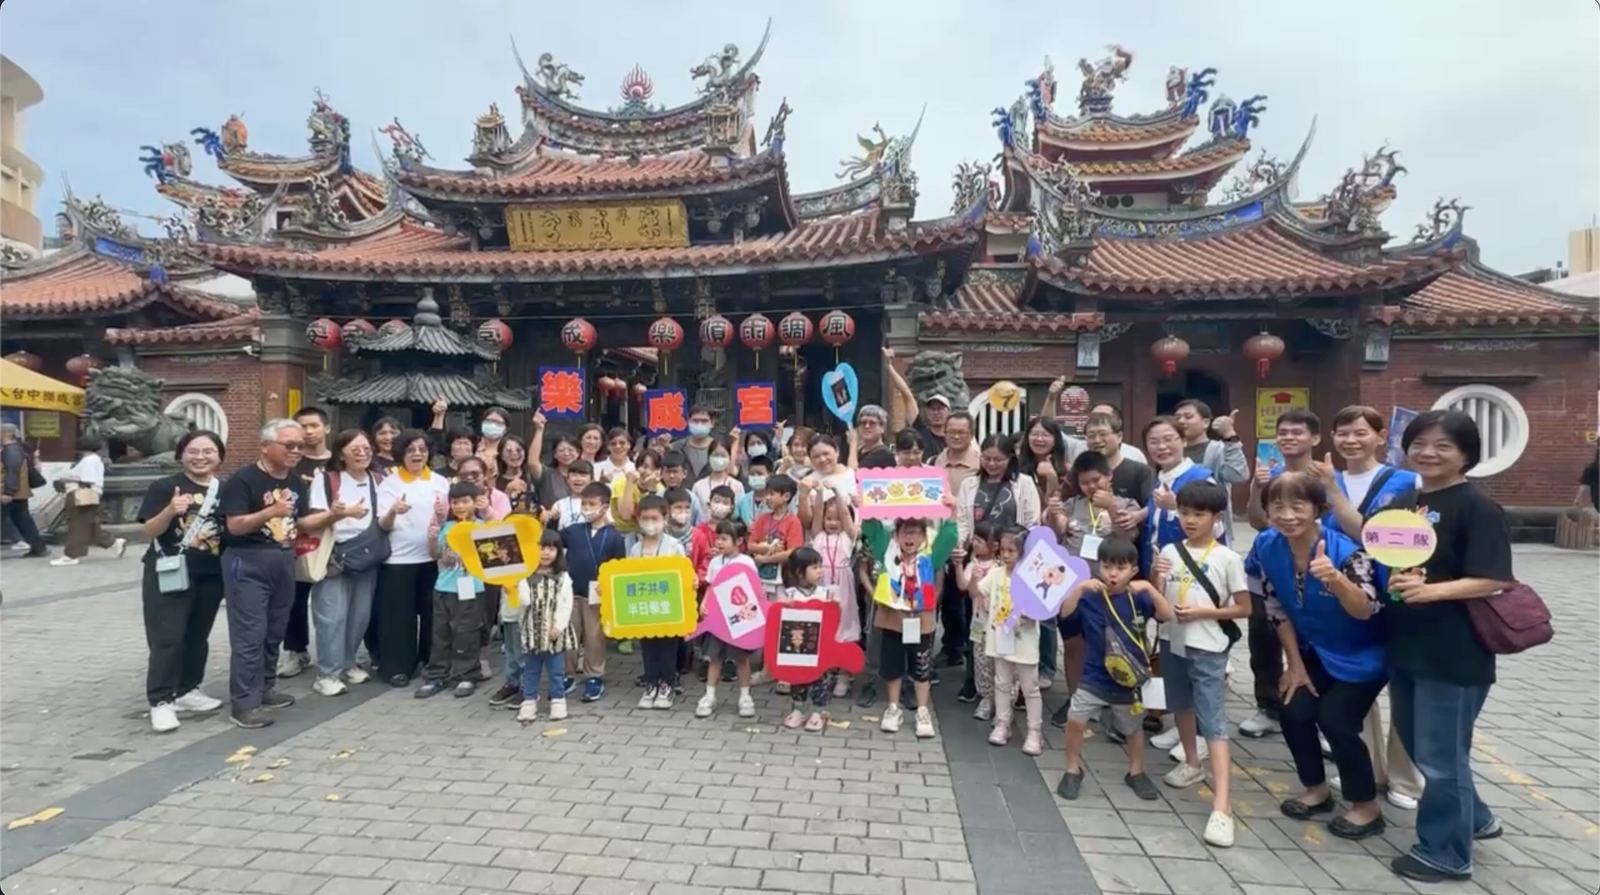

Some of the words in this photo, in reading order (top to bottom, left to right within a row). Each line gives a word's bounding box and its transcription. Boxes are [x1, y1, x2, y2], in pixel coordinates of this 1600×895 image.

[650, 322, 677, 344] 樂
[700, 319, 727, 342] 順
[743, 317, 767, 341] 雨
[782, 317, 806, 341] 調
[823, 314, 851, 337] 風
[541, 370, 584, 413] 樂
[1001, 389, 1016, 409] 7
[648, 391, 689, 432] 成
[736, 385, 774, 425] 宮
[1365, 531, 1429, 547] 第二隊
